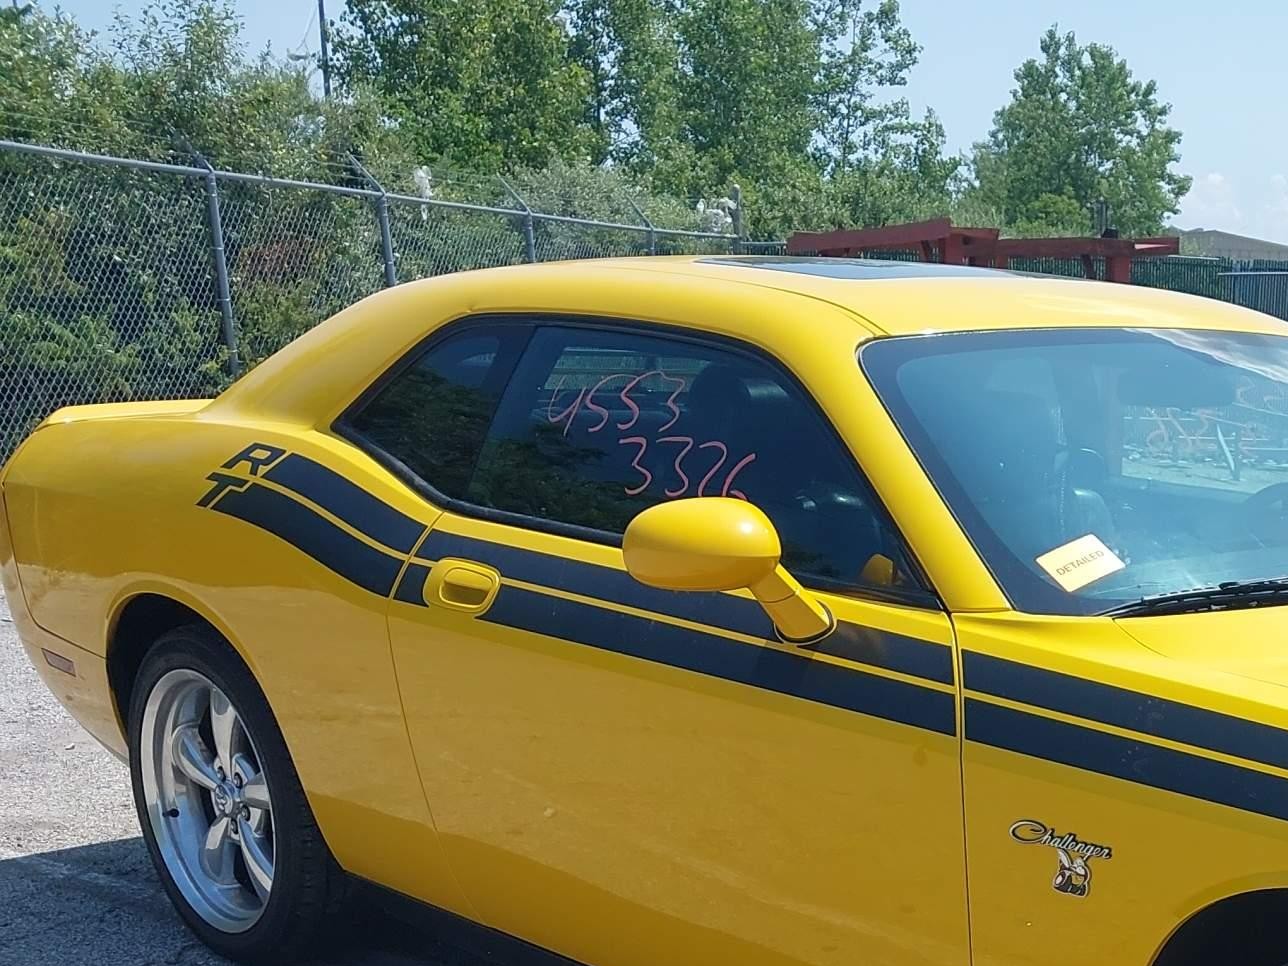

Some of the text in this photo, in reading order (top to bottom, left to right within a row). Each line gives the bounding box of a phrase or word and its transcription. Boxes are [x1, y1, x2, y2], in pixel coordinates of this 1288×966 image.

[548, 370, 686, 438] 4553
[1055, 550, 1105, 576] DETAILED
[1008, 819, 1112, 861] Challenger
